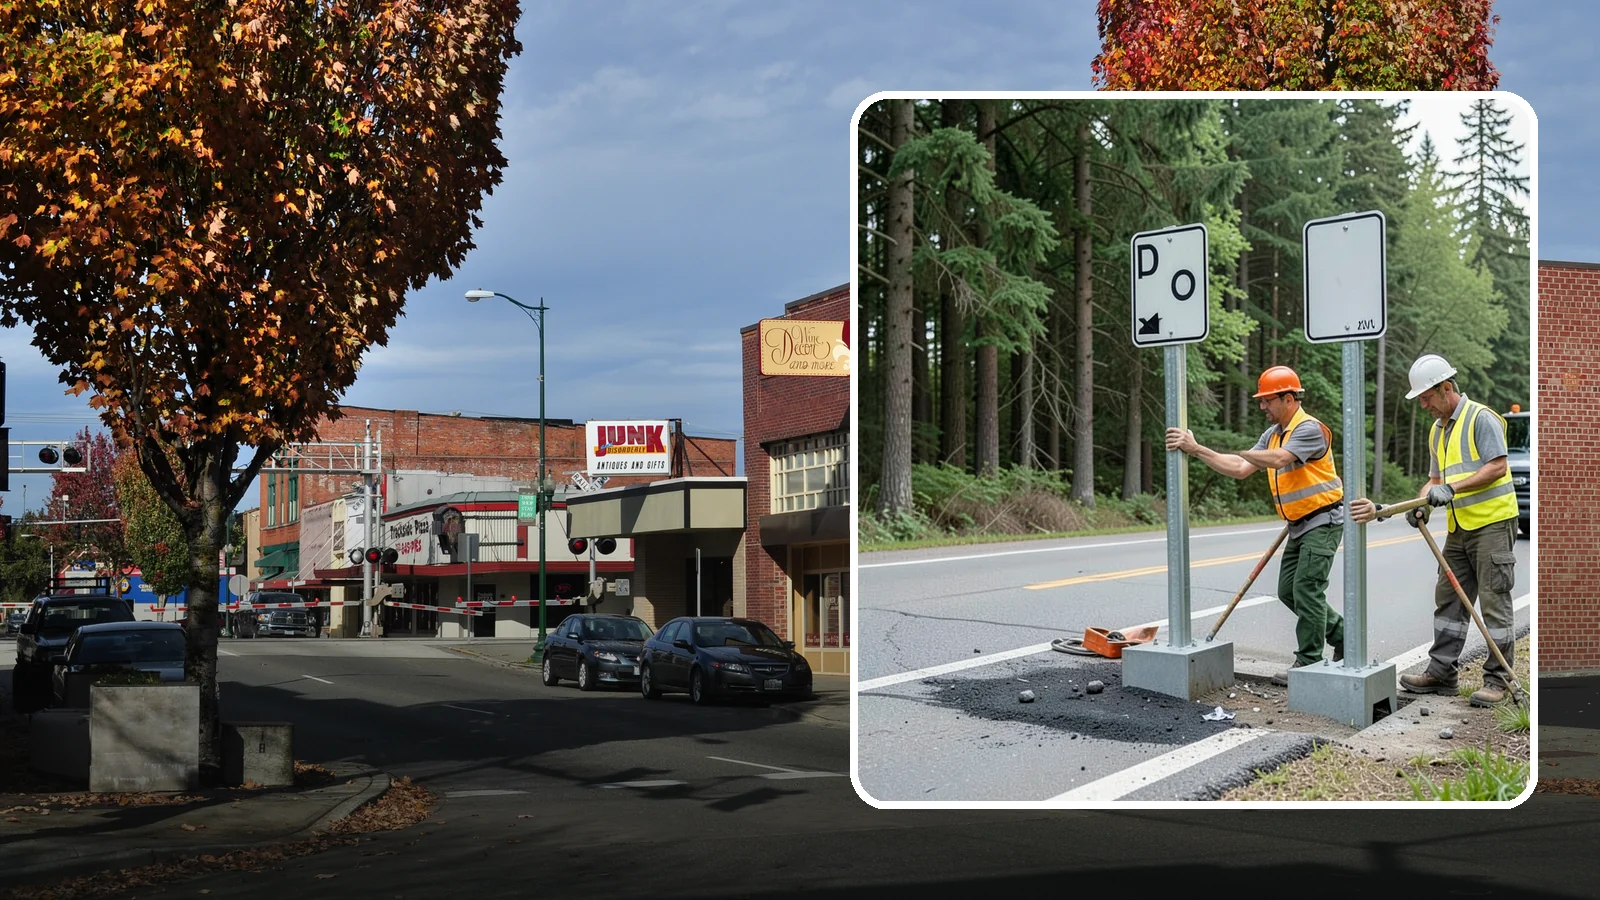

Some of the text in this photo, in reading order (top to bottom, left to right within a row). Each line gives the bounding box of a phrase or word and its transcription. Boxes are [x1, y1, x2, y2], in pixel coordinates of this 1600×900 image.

[595, 425, 666, 457] JUNK
[607, 446, 646, 454] DISORDERLY
[596, 461, 665, 470] ANTIQUES AND GIFTS
[572, 473, 589, 493] RAIL
[390, 520, 429, 540] Trackside Pizza
